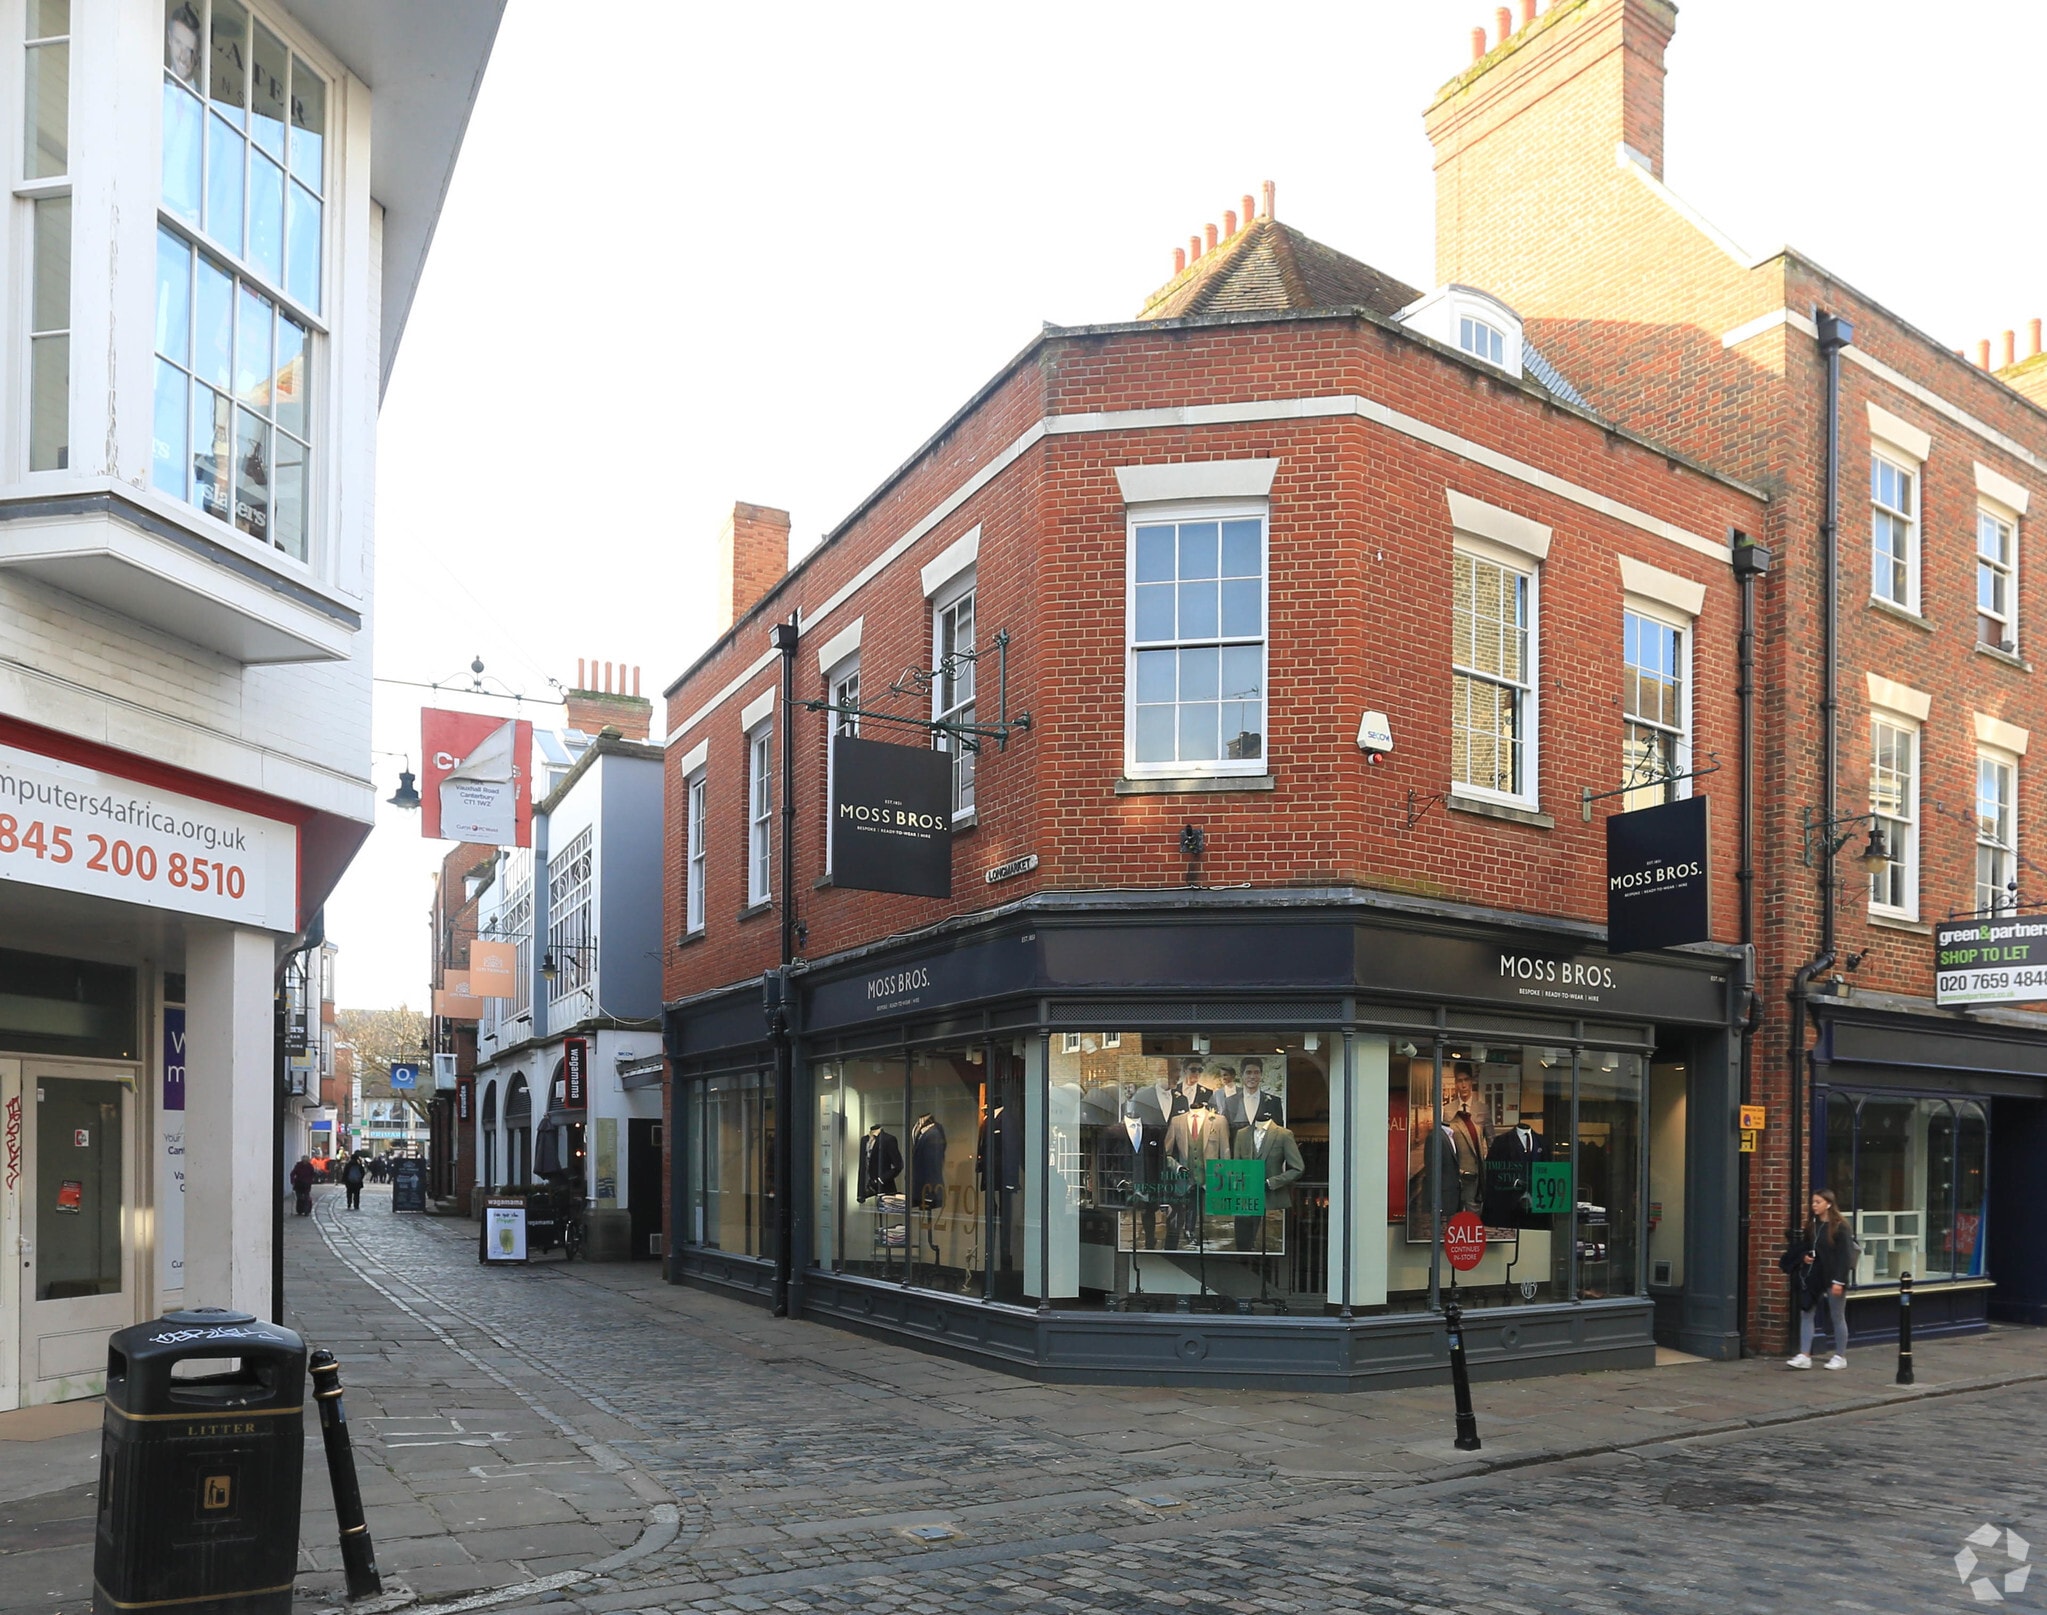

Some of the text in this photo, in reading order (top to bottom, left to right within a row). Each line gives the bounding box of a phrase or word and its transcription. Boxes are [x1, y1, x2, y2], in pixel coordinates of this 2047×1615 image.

[456, 784, 482, 792] Vauxhall
[460, 792, 495, 801] Canterbury
[840, 803, 947, 831] MOSS BROS.
[0, 813, 245, 899] 845 200 8510
[988, 857, 1031, 882] LONGMARKET
[1610, 861, 1702, 891] MOSS BROS.
[1939, 922, 2047, 946] green&partner
[1940, 945, 2030, 965] SHOP TO LET
[1500, 954, 1617, 989] MOSS BROS.
[1940, 970, 2047, 992] 020 7659 484
[867, 967, 930, 999] MOSS BROS.
[1519, 988, 1540, 996] BESPOKE
[1545, 991, 1584, 1001] READY-TO-WEAR
[569, 1048, 580, 1099] wagamama
[370, 1130, 407, 1138] PRIMARK
[487, 1199, 524, 1207] wagamama
[1536, 1177, 1567, 1209] £99
[921, 1183, 979, 1235] £279
[1235, 1198, 1259, 1212] FREE
[1447, 1225, 1484, 1245] SALE
[1450, 1245, 1481, 1254] CONTINUES
[1453, 1253, 1477, 1261] IN-STORE
[188, 1423, 255, 1436] LITTER
